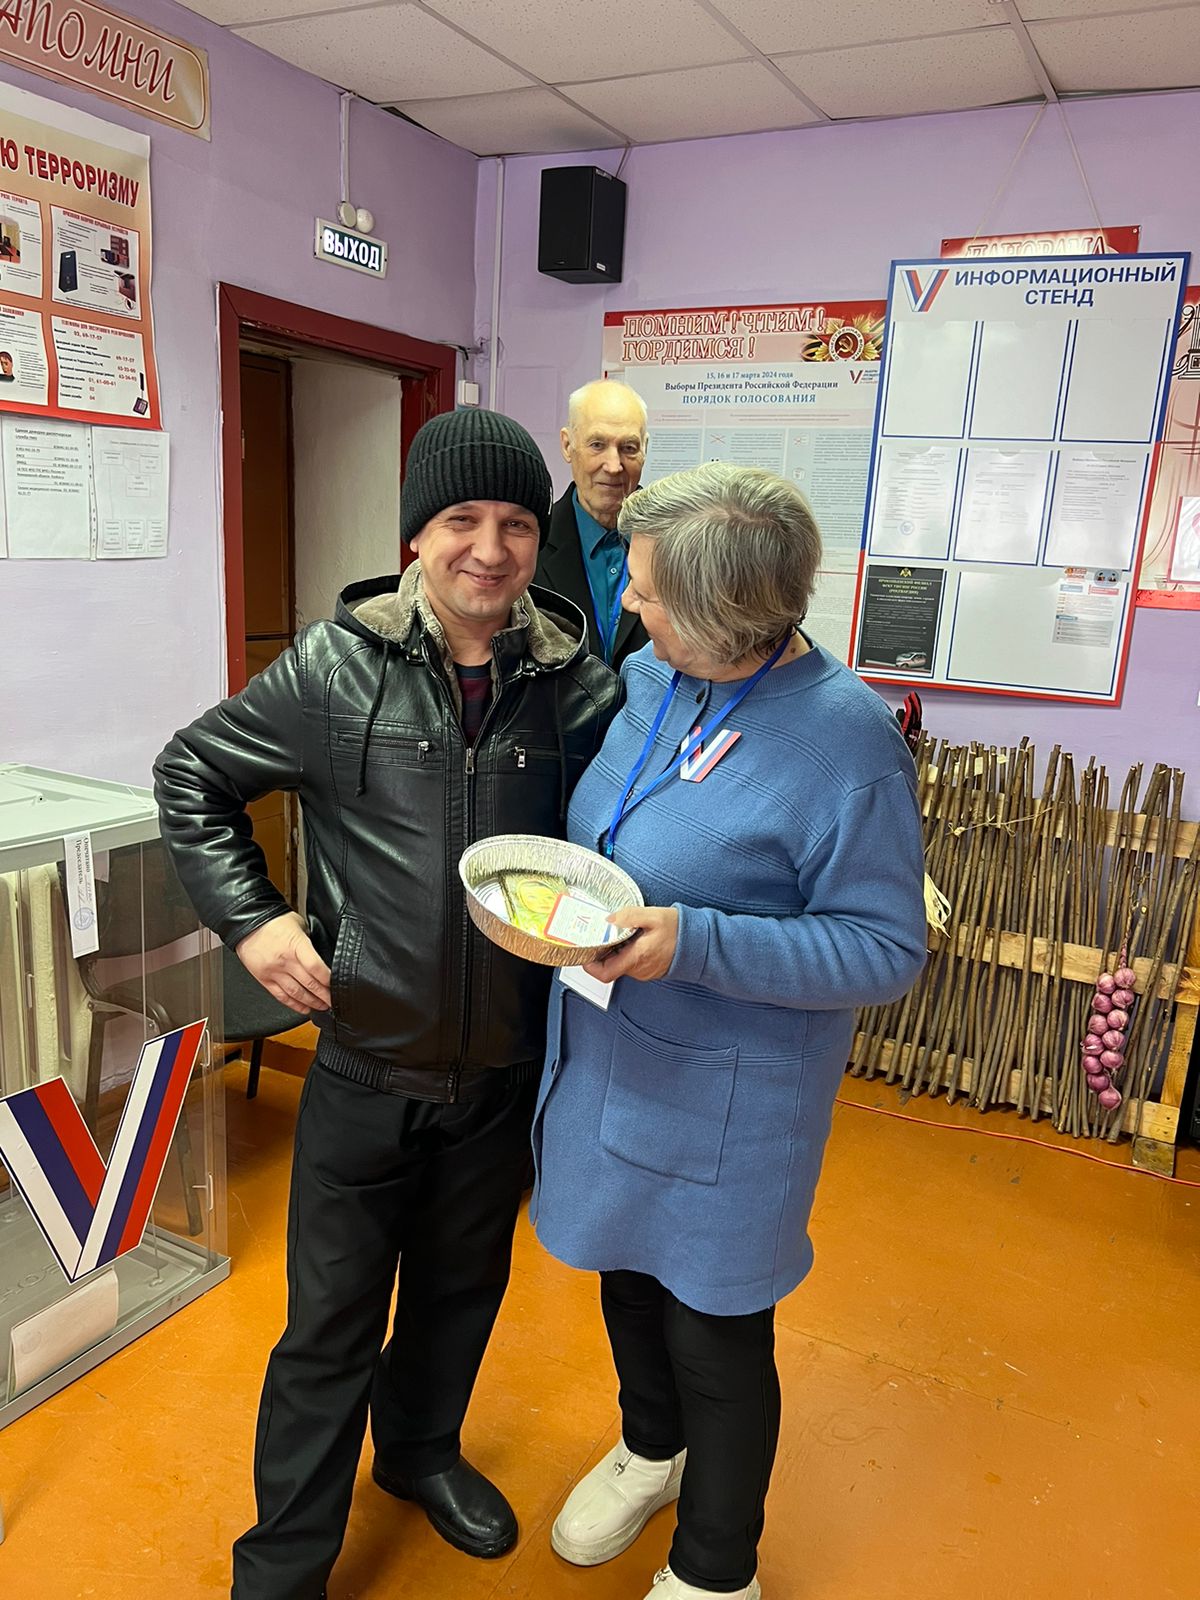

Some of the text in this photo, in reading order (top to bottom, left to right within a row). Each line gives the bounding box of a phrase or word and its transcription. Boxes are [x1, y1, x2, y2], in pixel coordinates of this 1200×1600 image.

[24, 145, 139, 208] ТЕРРОРИЗМУ
[323, 228, 380, 271] ВЫХОД
[955, 262, 1177, 287] ИНФОРМАЦИОННЫЙ
[1025, 288, 1094, 307] СТЕНД
[665, 380, 838, 392] Выборы Президента Российской Федерации
[682, 393, 816, 404] ПОРЯДОК ГОЛОСОВАНИЯ
